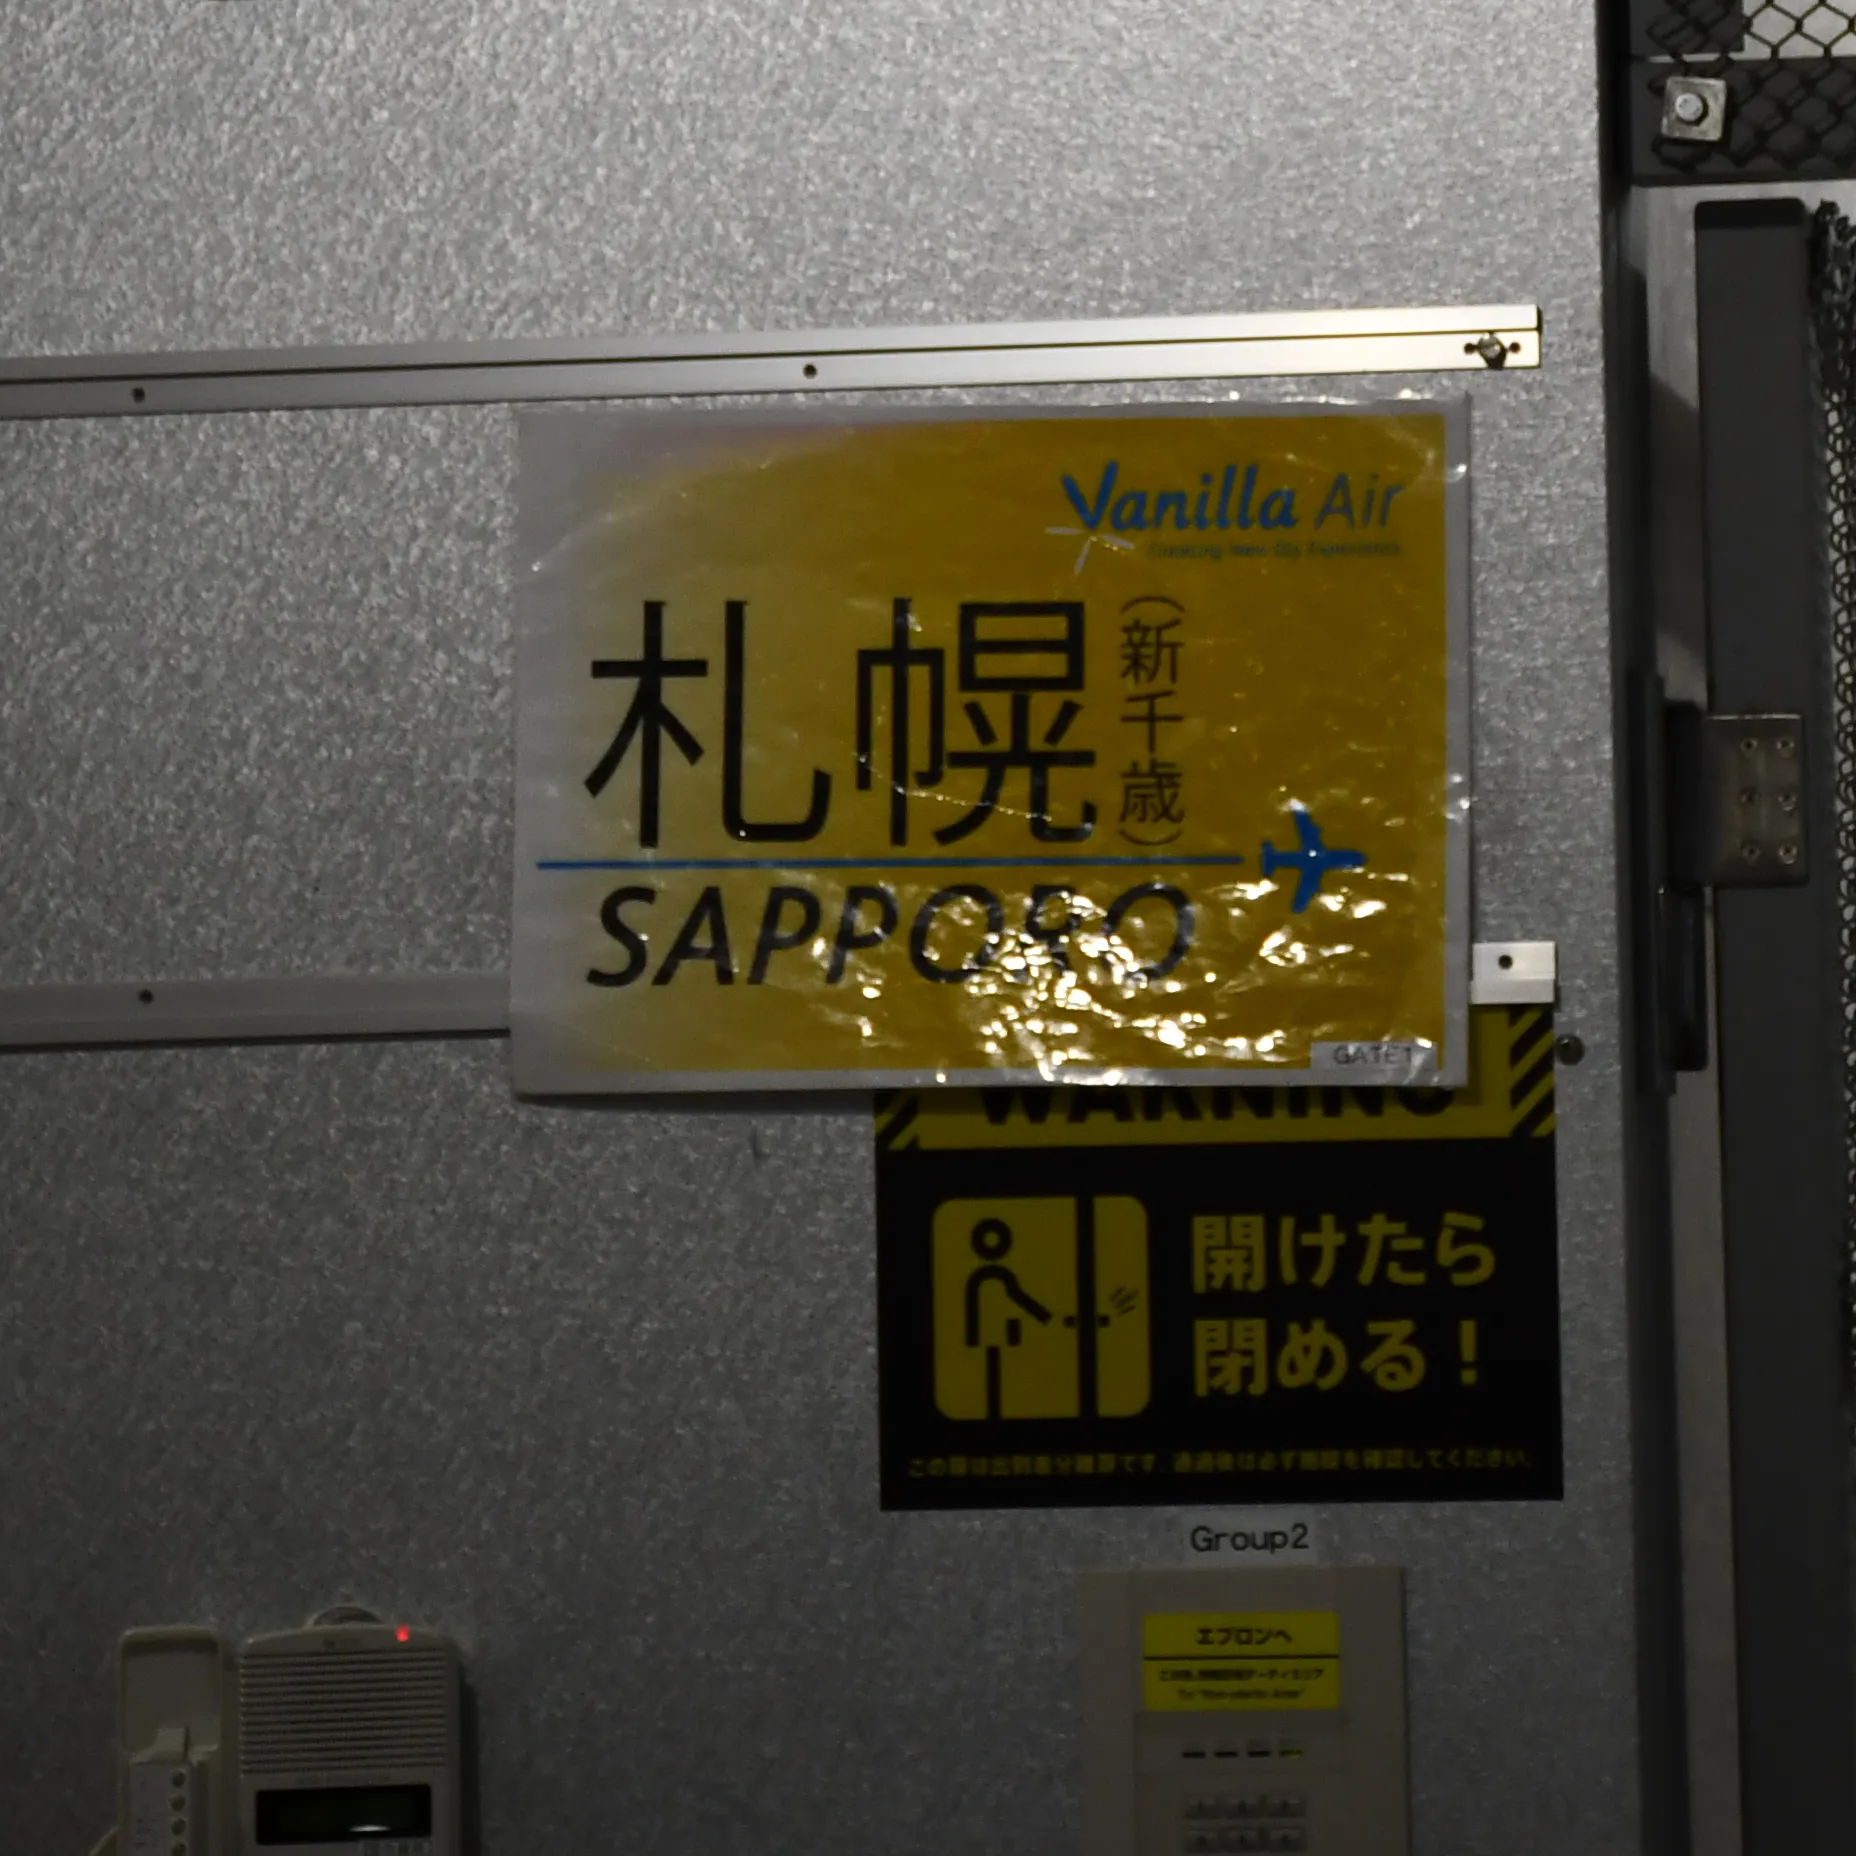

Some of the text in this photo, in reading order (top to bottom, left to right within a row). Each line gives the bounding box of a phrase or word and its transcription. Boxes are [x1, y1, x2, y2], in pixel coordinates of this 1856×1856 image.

[1061, 459, 1405, 530] Vanilla Air
[584, 597, 1098, 850] 札幌
[586, 882, 1196, 988] SAPPORO
[1189, 1210, 1496, 1295] 開けたら
[1191, 1318, 1481, 1398] 閉める！
[1190, 1523, 1310, 1553] Group2
